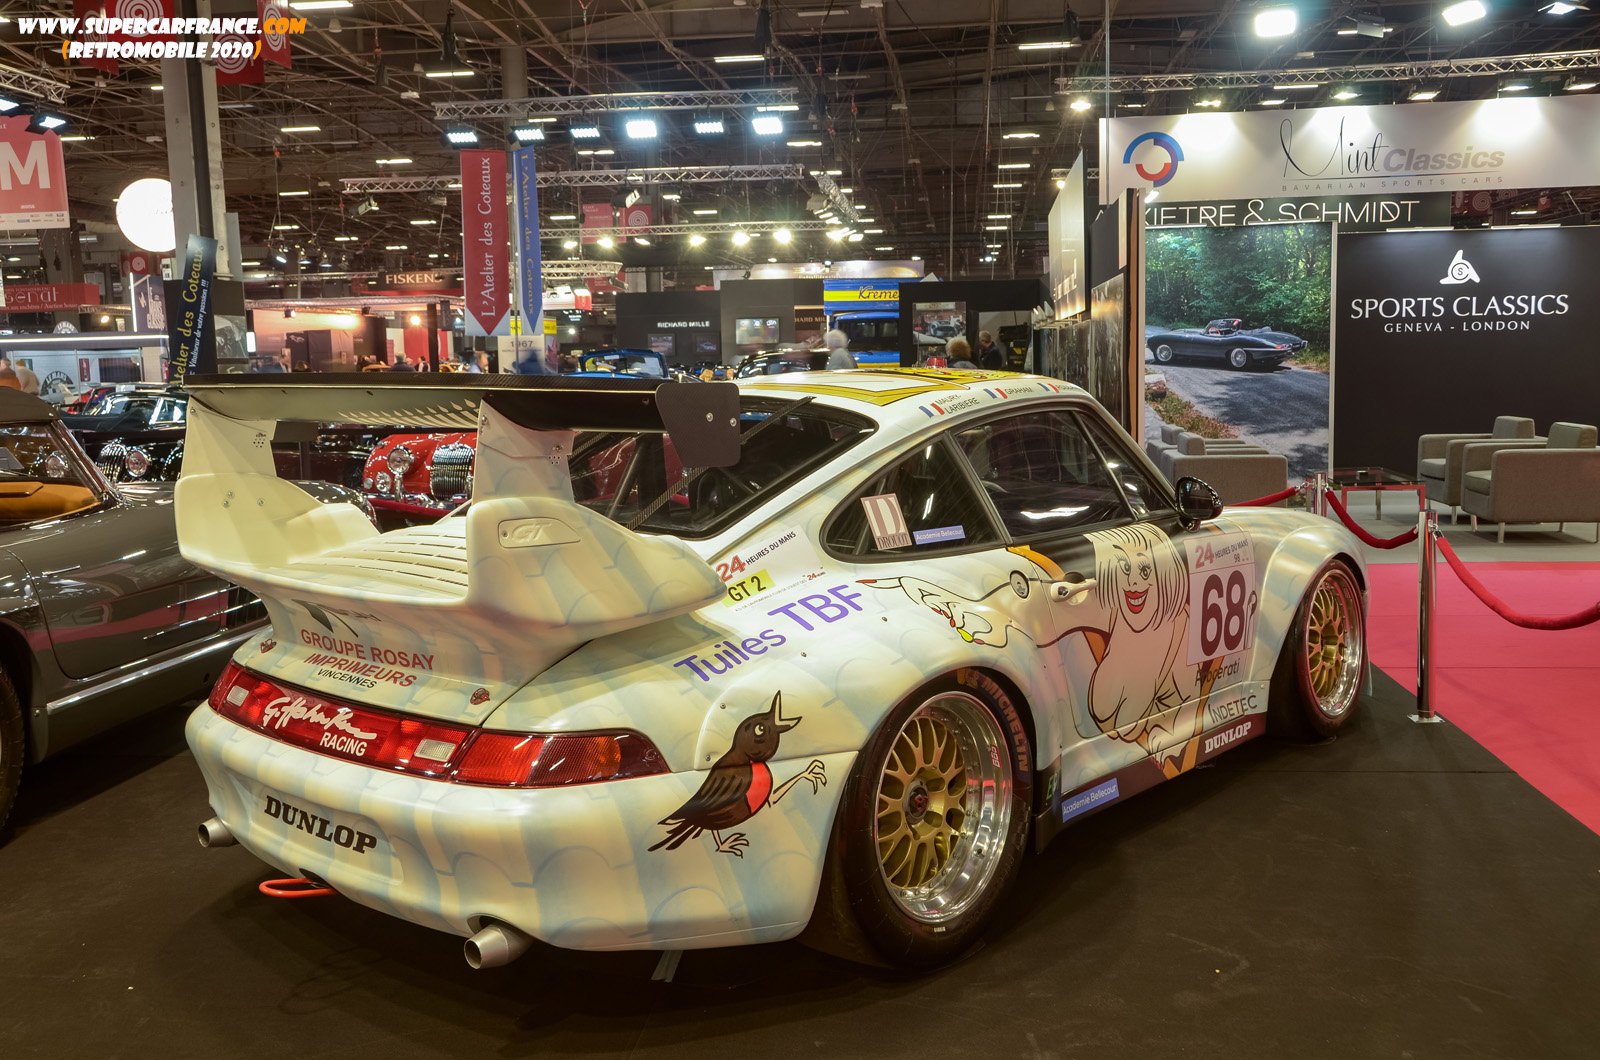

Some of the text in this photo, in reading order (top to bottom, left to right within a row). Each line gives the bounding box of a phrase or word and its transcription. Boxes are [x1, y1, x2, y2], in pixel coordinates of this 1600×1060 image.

[0, 140, 51, 190] M
[1383, 146, 1504, 172] Classics
[1282, 176, 1503, 192] BAVARIAN SPORTS CARS
[1243, 199, 1265, 226] &
[1278, 201, 1421, 224] SCHMIDT
[477, 157, 496, 317] L'Atelier des Coteaux
[521, 155, 535, 315] L'Atelier des Coteaux
[182, 246, 204, 303] Coteaux
[1350, 294, 1569, 319] SPORTS CLASSICS
[177, 311, 194, 337] des
[193, 327, 201, 338] de
[657, 321, 687, 329] RICHARD
[1384, 322, 1443, 333] GENEVA
[1462, 320, 1530, 332] LONDON
[1004, 386, 1034, 395] GRAHAM
[877, 533, 910, 549] DROUOT
[916, 528, 964, 540] Academie Bellecour
[716, 531, 797, 582] 24 HEURES DU MANS
[1195, 539, 1249, 569] 24 HEURES DU MANS
[727, 576, 766, 602] GT 2
[1201, 570, 1246, 656] 68
[673, 584, 863, 682] Tuiles TBF
[301, 628, 435, 671] GROUPE ROSAY
[304, 653, 418, 687] IMPRIMEURS
[317, 668, 377, 689] VINCENNES
[981, 677, 1029, 772] MICHELIN
[1204, 721, 1252, 754] DUNLOP
[320, 732, 367, 757] RACING
[1063, 783, 1117, 815] Academie Bellecour
[264, 795, 377, 854] DUNLOP
